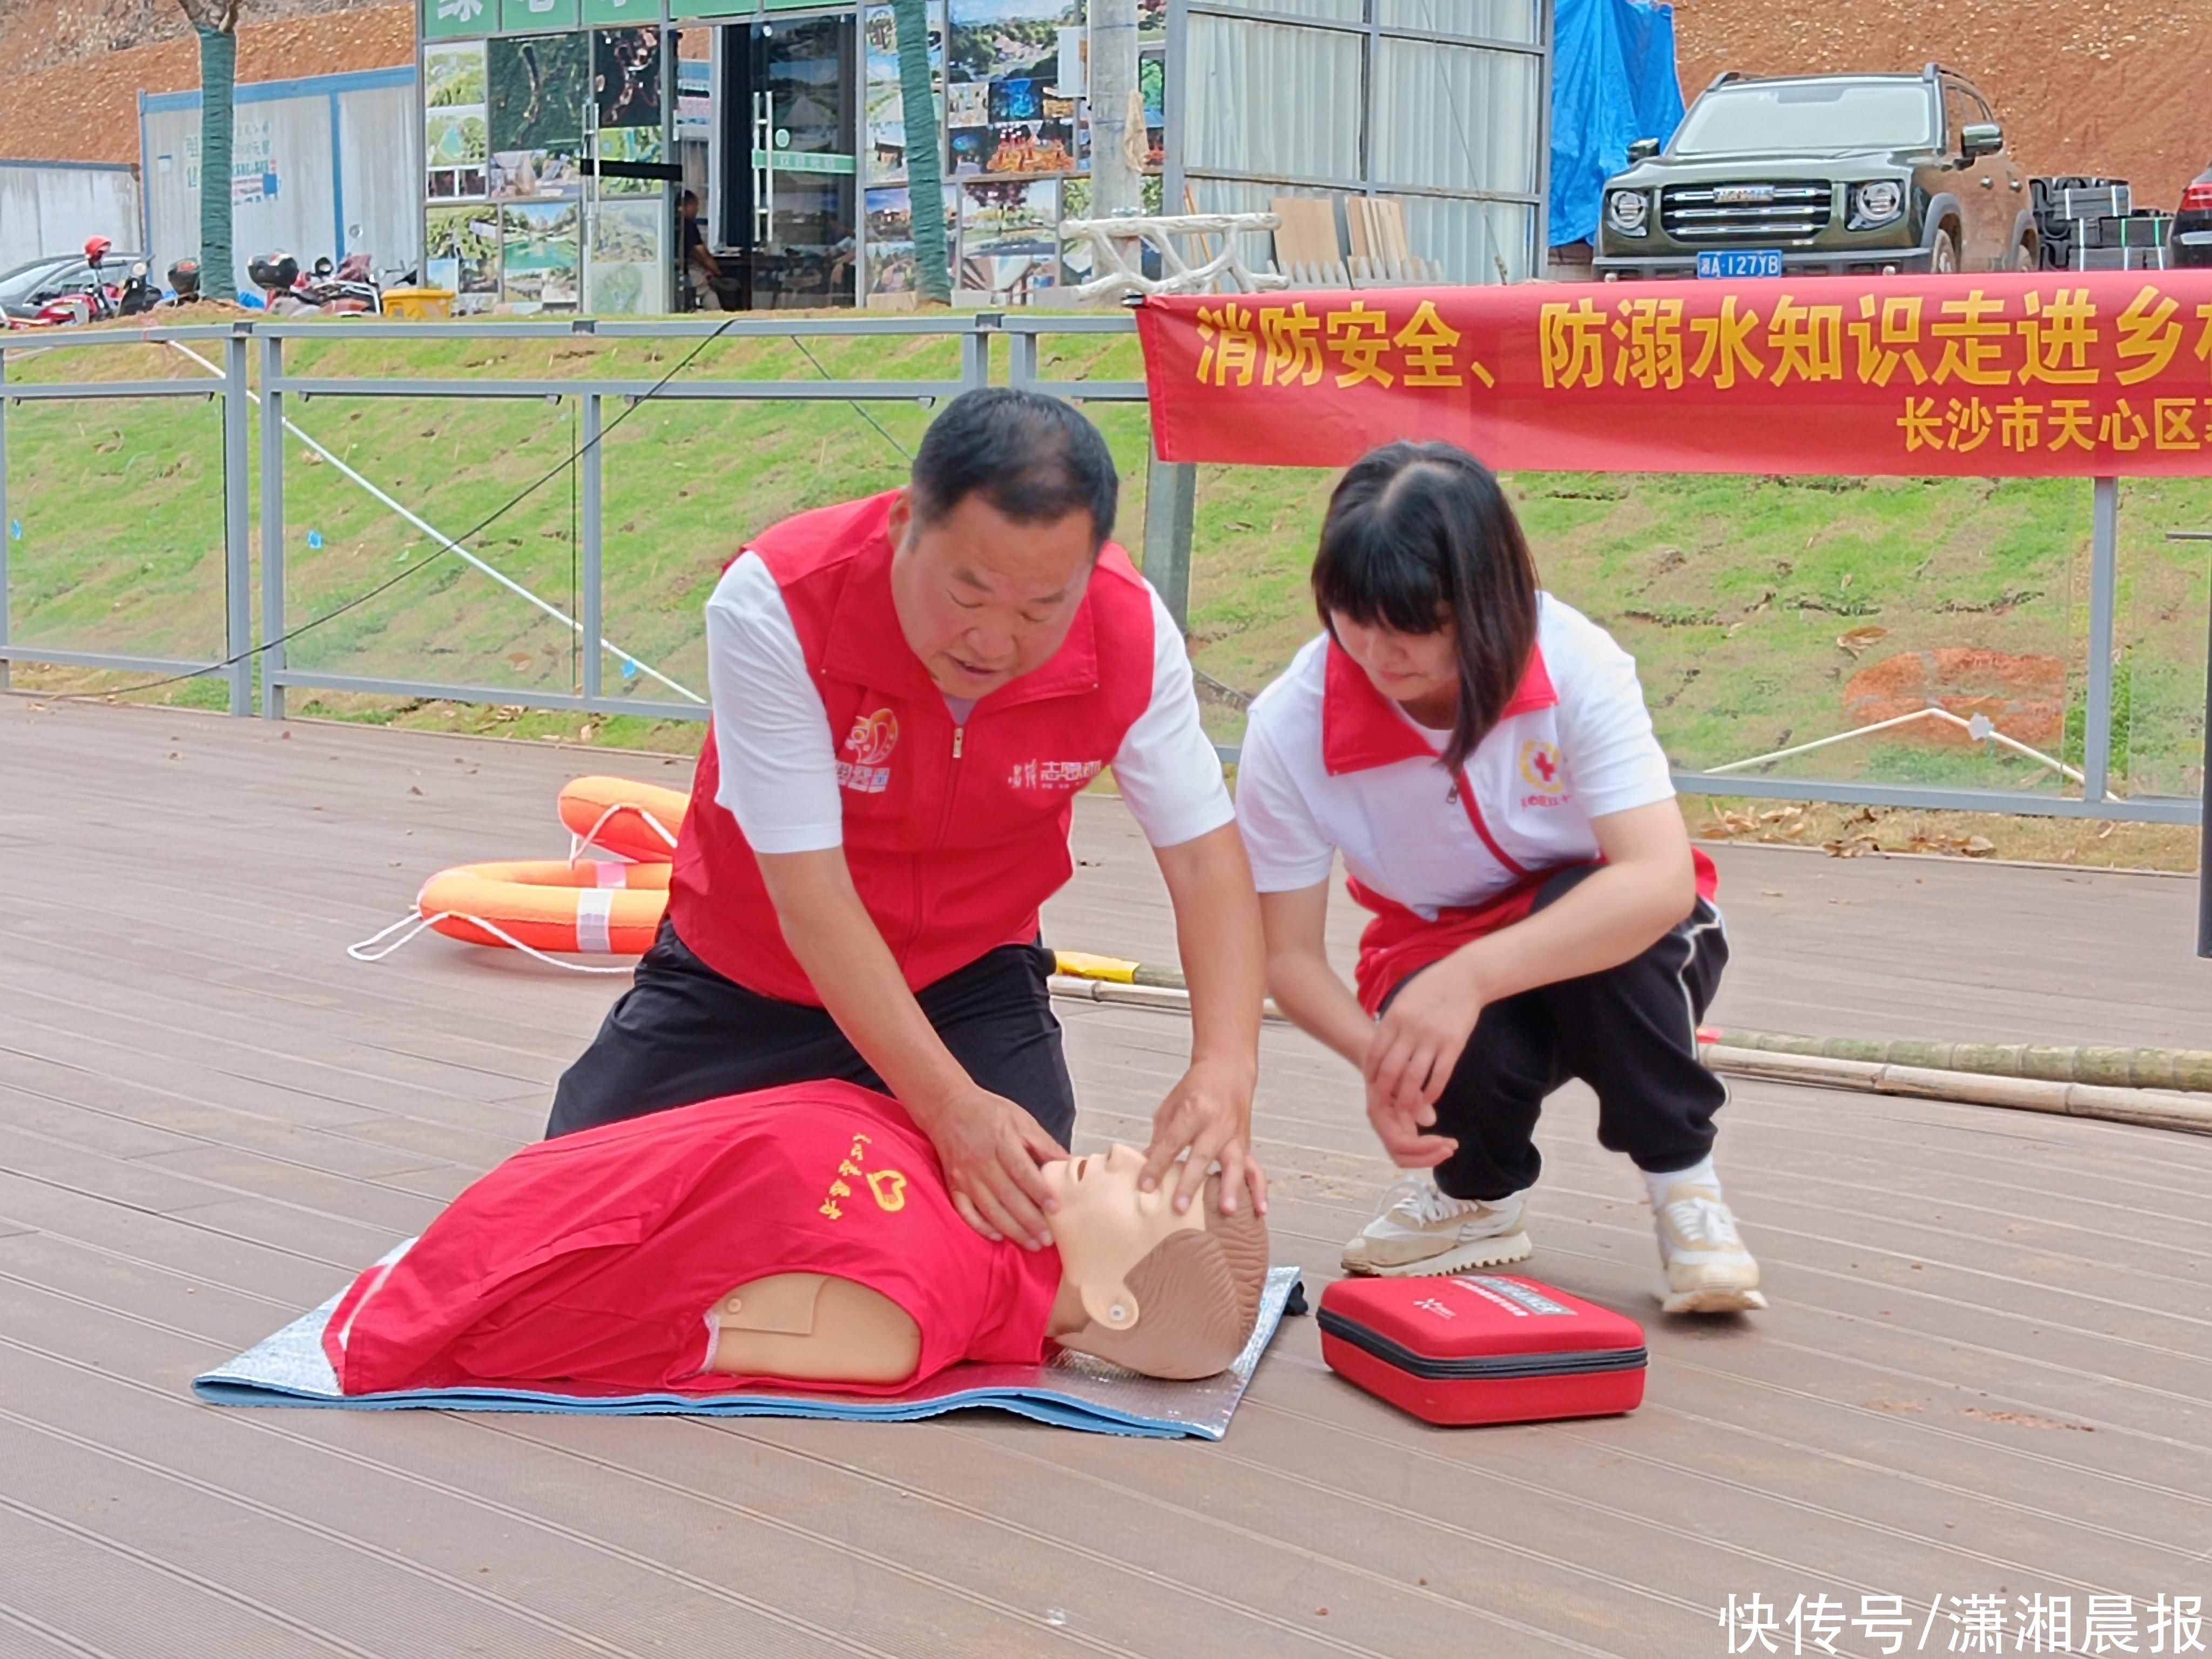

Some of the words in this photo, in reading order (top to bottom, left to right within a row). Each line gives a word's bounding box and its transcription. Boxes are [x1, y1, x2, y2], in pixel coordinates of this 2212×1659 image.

[1896, 396, 2212, 454] 长沙市天心区
